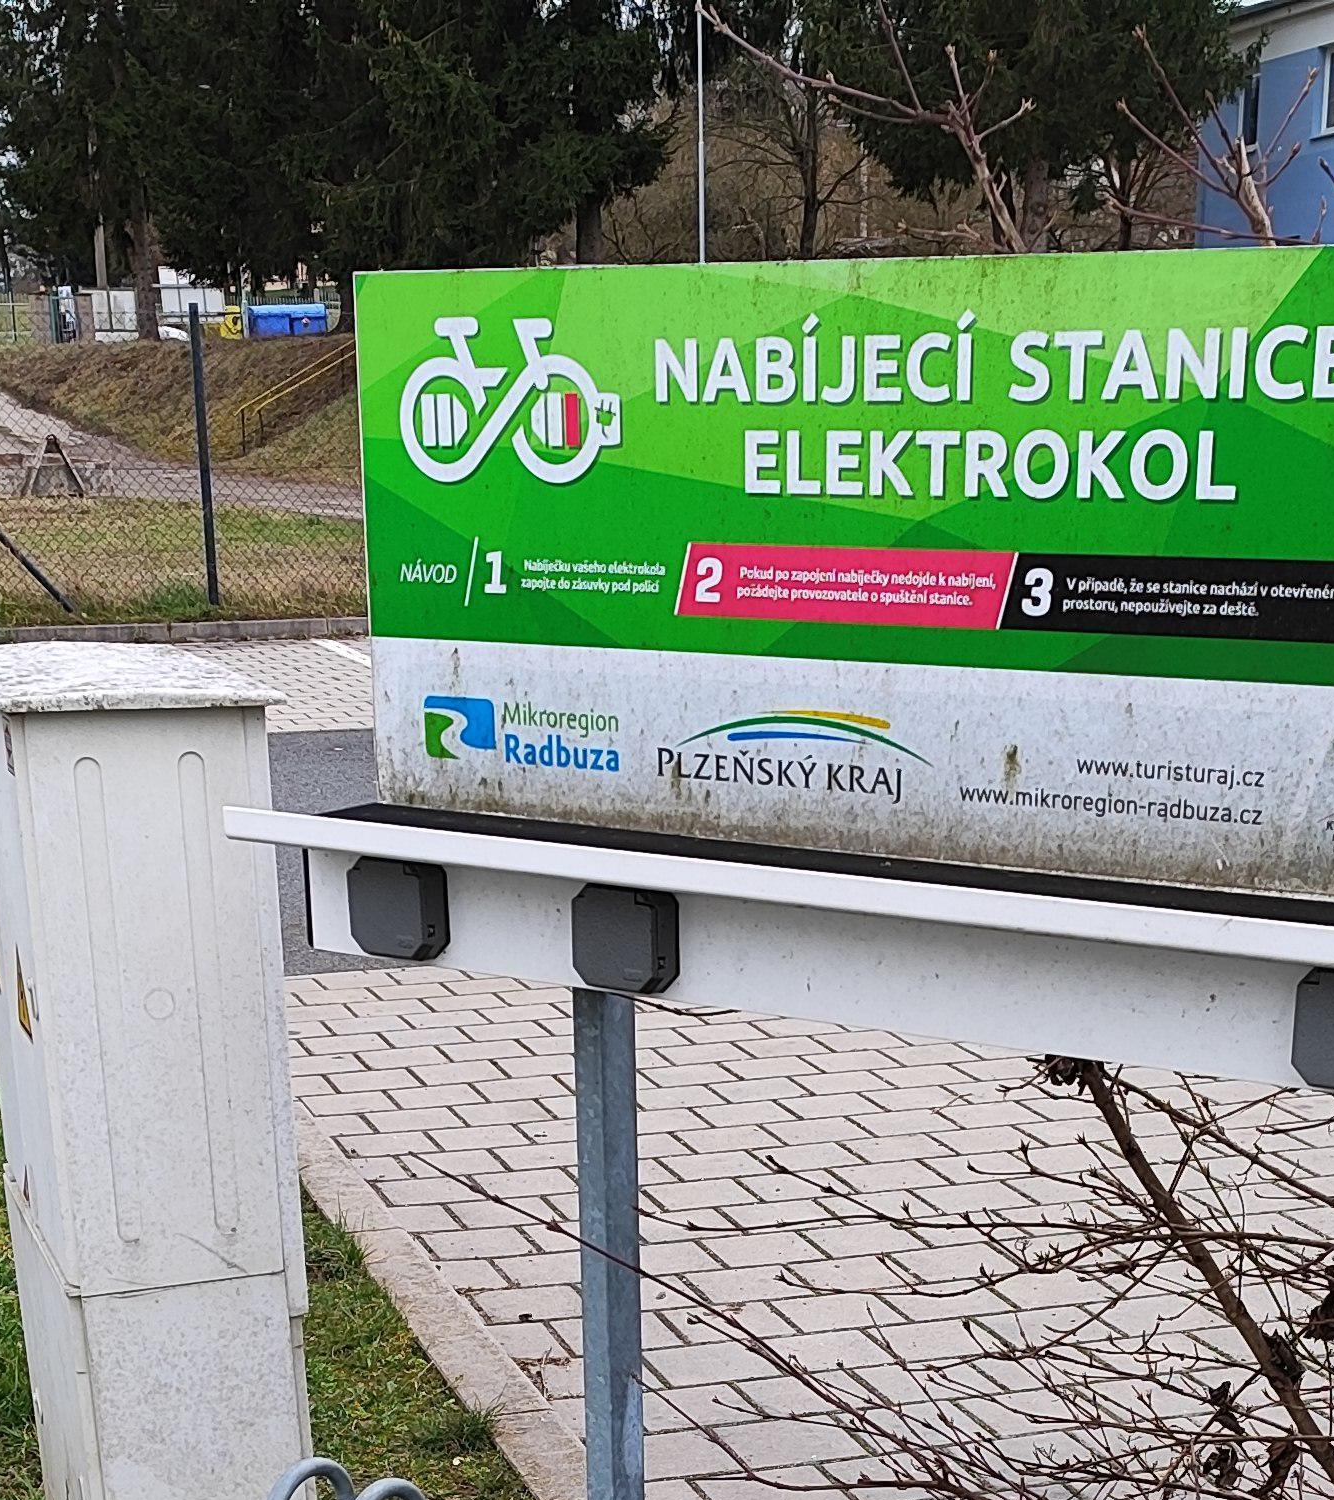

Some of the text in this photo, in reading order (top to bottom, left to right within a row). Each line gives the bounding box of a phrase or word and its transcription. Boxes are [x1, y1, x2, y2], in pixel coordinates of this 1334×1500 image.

[654, 310, 976, 404] NABÍJECÍ
[743, 430, 1237, 501] ELEKTROKOL
[400, 558, 457, 583] NÁVOD
[484, 551, 507, 594] 1
[521, 578, 556, 592] zapojte
[557, 577, 570, 589] do
[571, 577, 610, 594] zásuvky
[611, 579, 631, 594] pod
[524, 559, 666, 576] Nabíječku vašeho elektrokola
[695, 557, 723, 603] 2
[739, 565, 996, 591] Pokud po zapojení nabíječky nedojde k nabíjení,
[736, 583, 974, 606] požádejte provozovatele o spuštění stanice.
[1021, 567, 1054, 617] 3
[1067, 577, 1077, 591] V
[1078, 576, 1128, 596] případě,
[1129, 576, 1144, 593] že
[1146, 582, 1160, 594] se
[1162, 579, 1207, 595] stanice
[1209, 580, 1258, 597] nachází
[1260, 586, 1267, 597] v
[1062, 597, 1259, 617] prostoru, nepoužívejte za deště.
[503, 701, 619, 738] Mikroregion
[504, 733, 620, 773] Radbuza
[657, 747, 903, 805] PLZEŇSKÝ KRAJ
[1076, 758, 1265, 791] www.turisturaj.cz
[959, 786, 1263, 826] www.mikroregion-radbuza.cz
